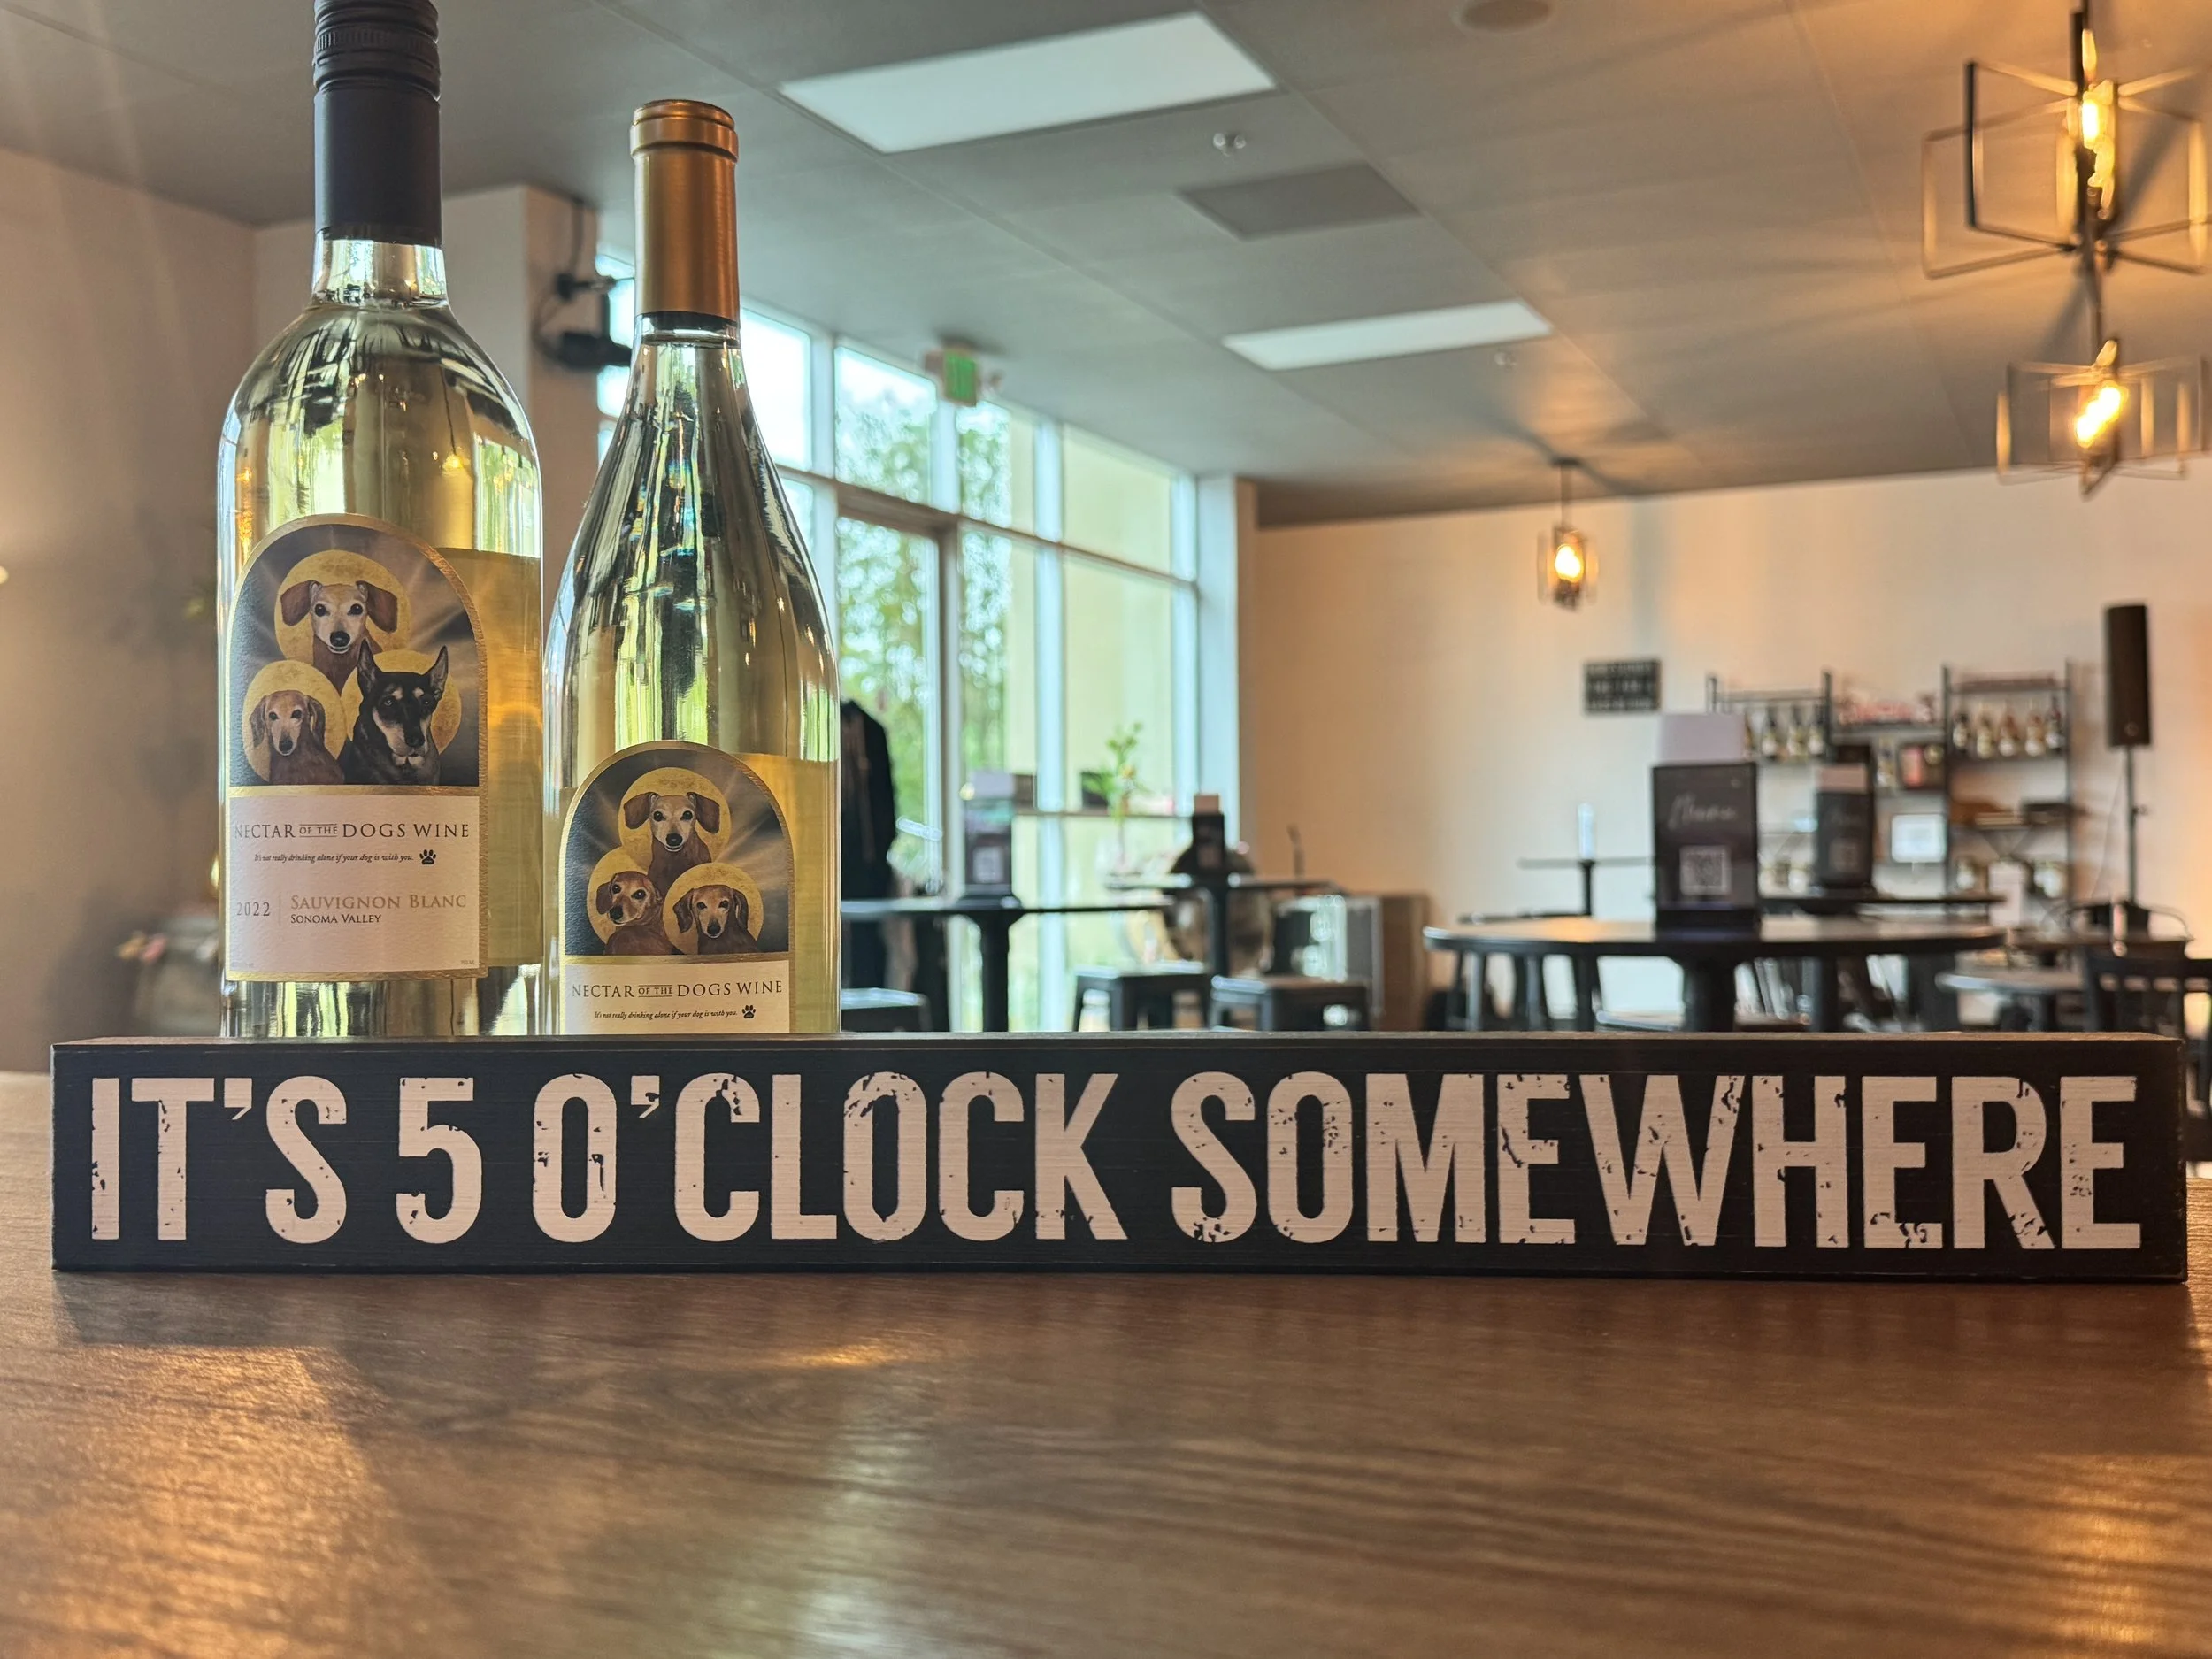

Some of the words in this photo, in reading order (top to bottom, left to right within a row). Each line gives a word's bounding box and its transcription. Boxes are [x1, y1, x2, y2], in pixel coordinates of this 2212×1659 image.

[234, 824, 296, 839] NECTAR
[299, 826, 314, 835] OF
[317, 826, 338, 835] THE
[342, 824, 406, 838] DOGS
[413, 823, 470, 838] WINE
[272, 854, 288, 864] really
[288, 854, 316, 864] drinking
[359, 854, 373, 863] dog
[236, 902, 271, 917] 2022
[290, 895, 400, 910] SAUVIGNON
[410, 894, 466, 909] BLANC
[290, 913, 338, 924] SONOMA
[341, 913, 382, 924] VALLEY
[572, 983, 635, 998] NECTAR
[654, 986, 673, 995] THE
[677, 982, 731, 997] DOGS
[735, 980, 782, 995] WINE
[612, 1011, 627, 1020] really
[627, 1011, 654, 1020] drinking
[92, 1076, 346, 1243] IT'S
[396, 1078, 482, 1243] 5
[533, 1072, 1127, 1242] O'CLOCK
[1171, 1071, 2139, 1248] SOMEWHERE
